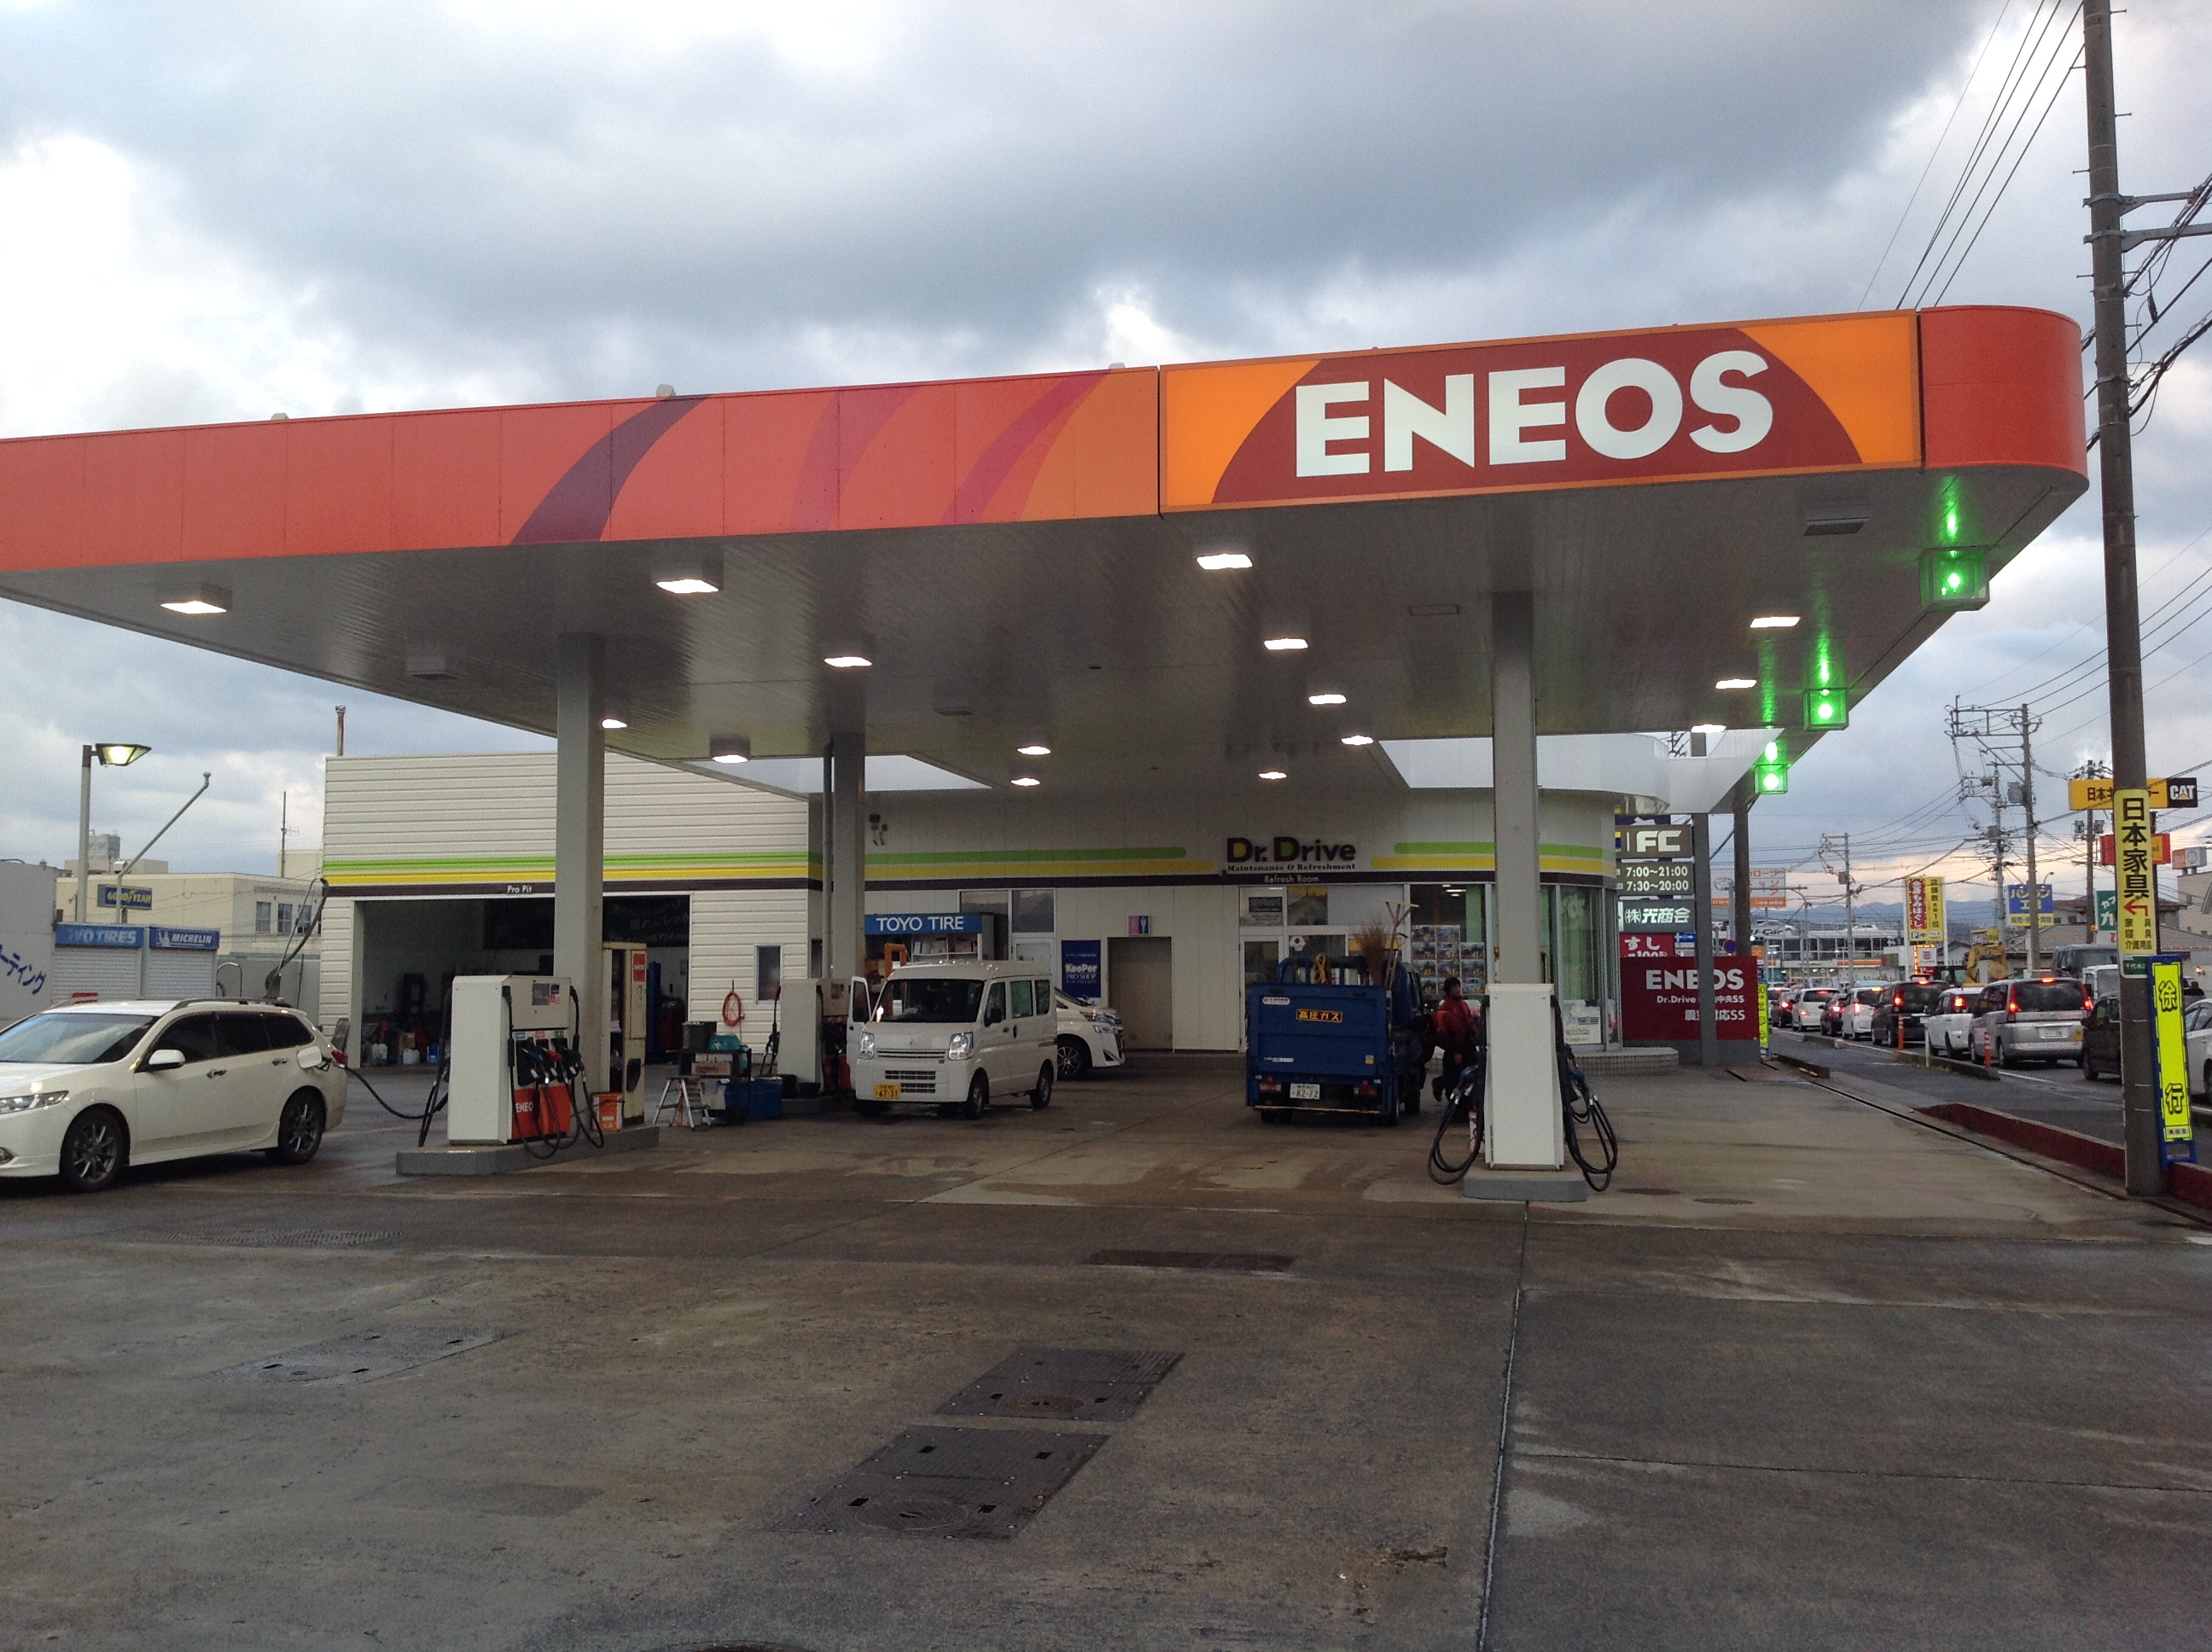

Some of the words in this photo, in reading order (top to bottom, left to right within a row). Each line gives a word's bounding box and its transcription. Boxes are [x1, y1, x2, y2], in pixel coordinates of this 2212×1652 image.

[1295, 350, 1774, 478] ENEOS
[2169, 785, 2195, 800] CAT
[1227, 837, 1267, 863] Dr.
[1274, 836, 1356, 862] Drive
[2122, 798, 2150, 899] 日本家具
[1264, 875, 1295, 883] Refresh
[1297, 875, 1319, 883] Room
[522, 884, 533, 893] Pit
[876, 916, 923, 932] TOYO
[928, 916, 964, 930] TIRE
[96, 928, 137, 945] TIRES
[171, 933, 212, 945] MICHELIN
[1623, 936, 1661, 951] すし
[0, 944, 47, 995] ーティング
[1065, 963, 1098, 973] KeePer
[1656, 995, 1697, 1003] Dr.Drive
[1298, 1010, 1340, 1021] 高圧ガス
[2157, 980, 2186, 1115] 徐行
[515, 1101, 534, 1114] ENEO
